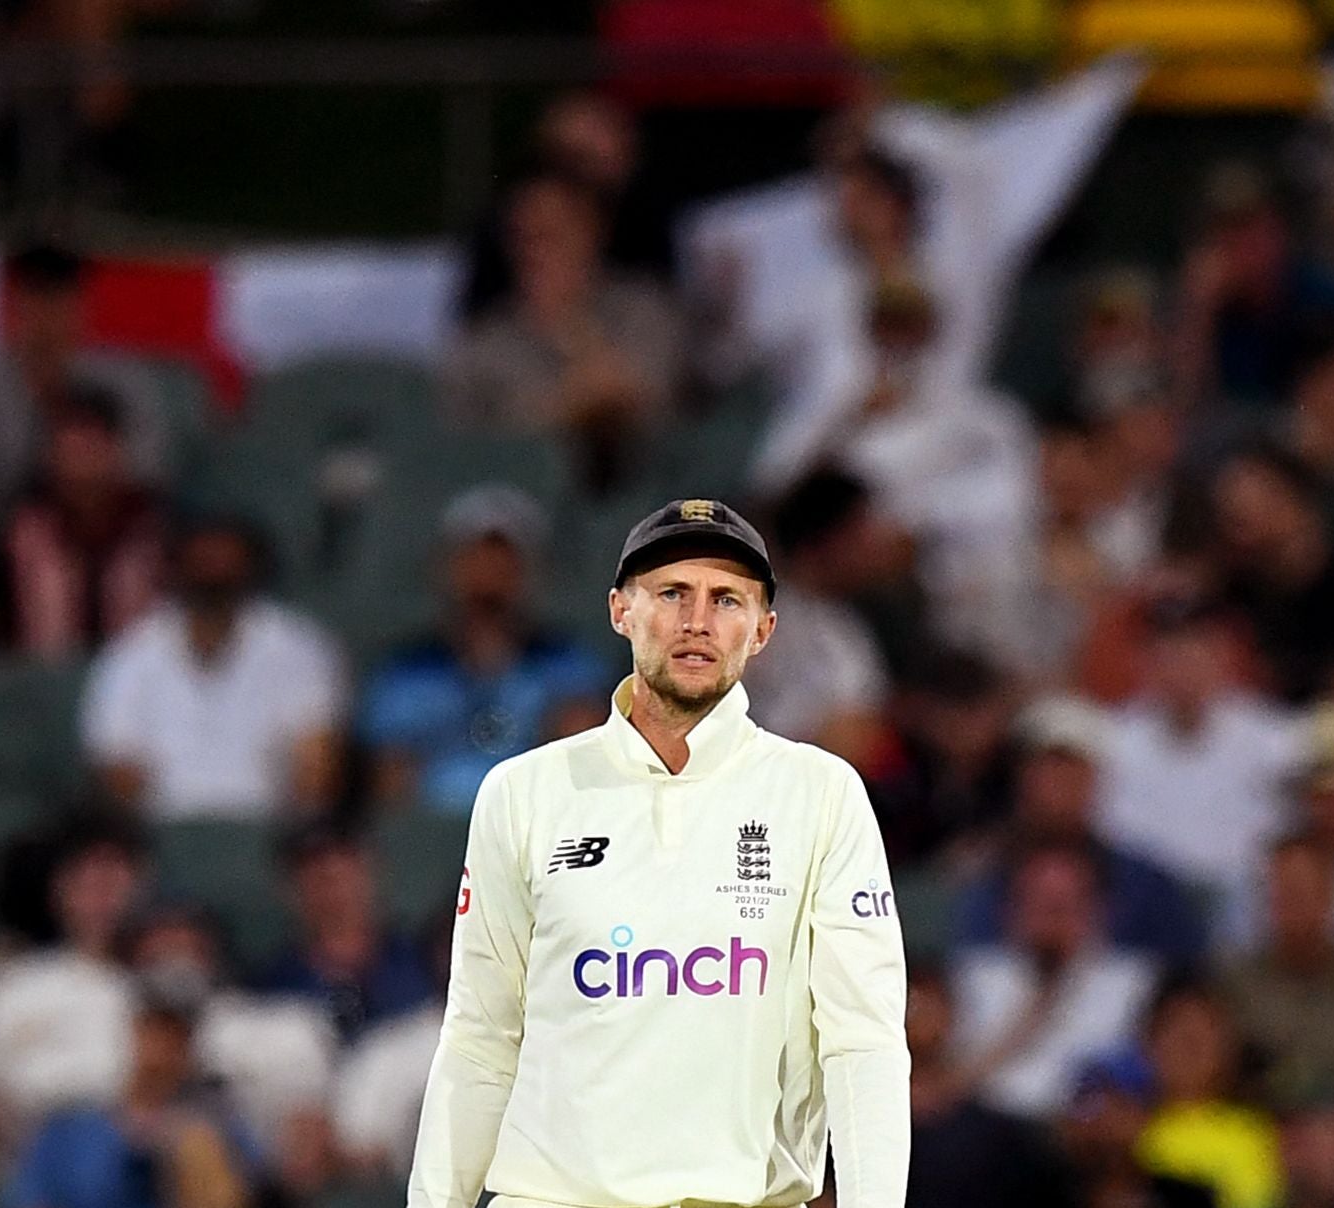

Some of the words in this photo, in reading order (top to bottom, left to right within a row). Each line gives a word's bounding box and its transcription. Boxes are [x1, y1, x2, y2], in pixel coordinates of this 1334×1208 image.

[715, 884, 751, 894] ASHES
[753, 885, 788, 897] SERIES
[734, 895, 771, 906] 2021/22
[739, 906, 765, 920] 655
[572, 924, 768, 999] cinch
